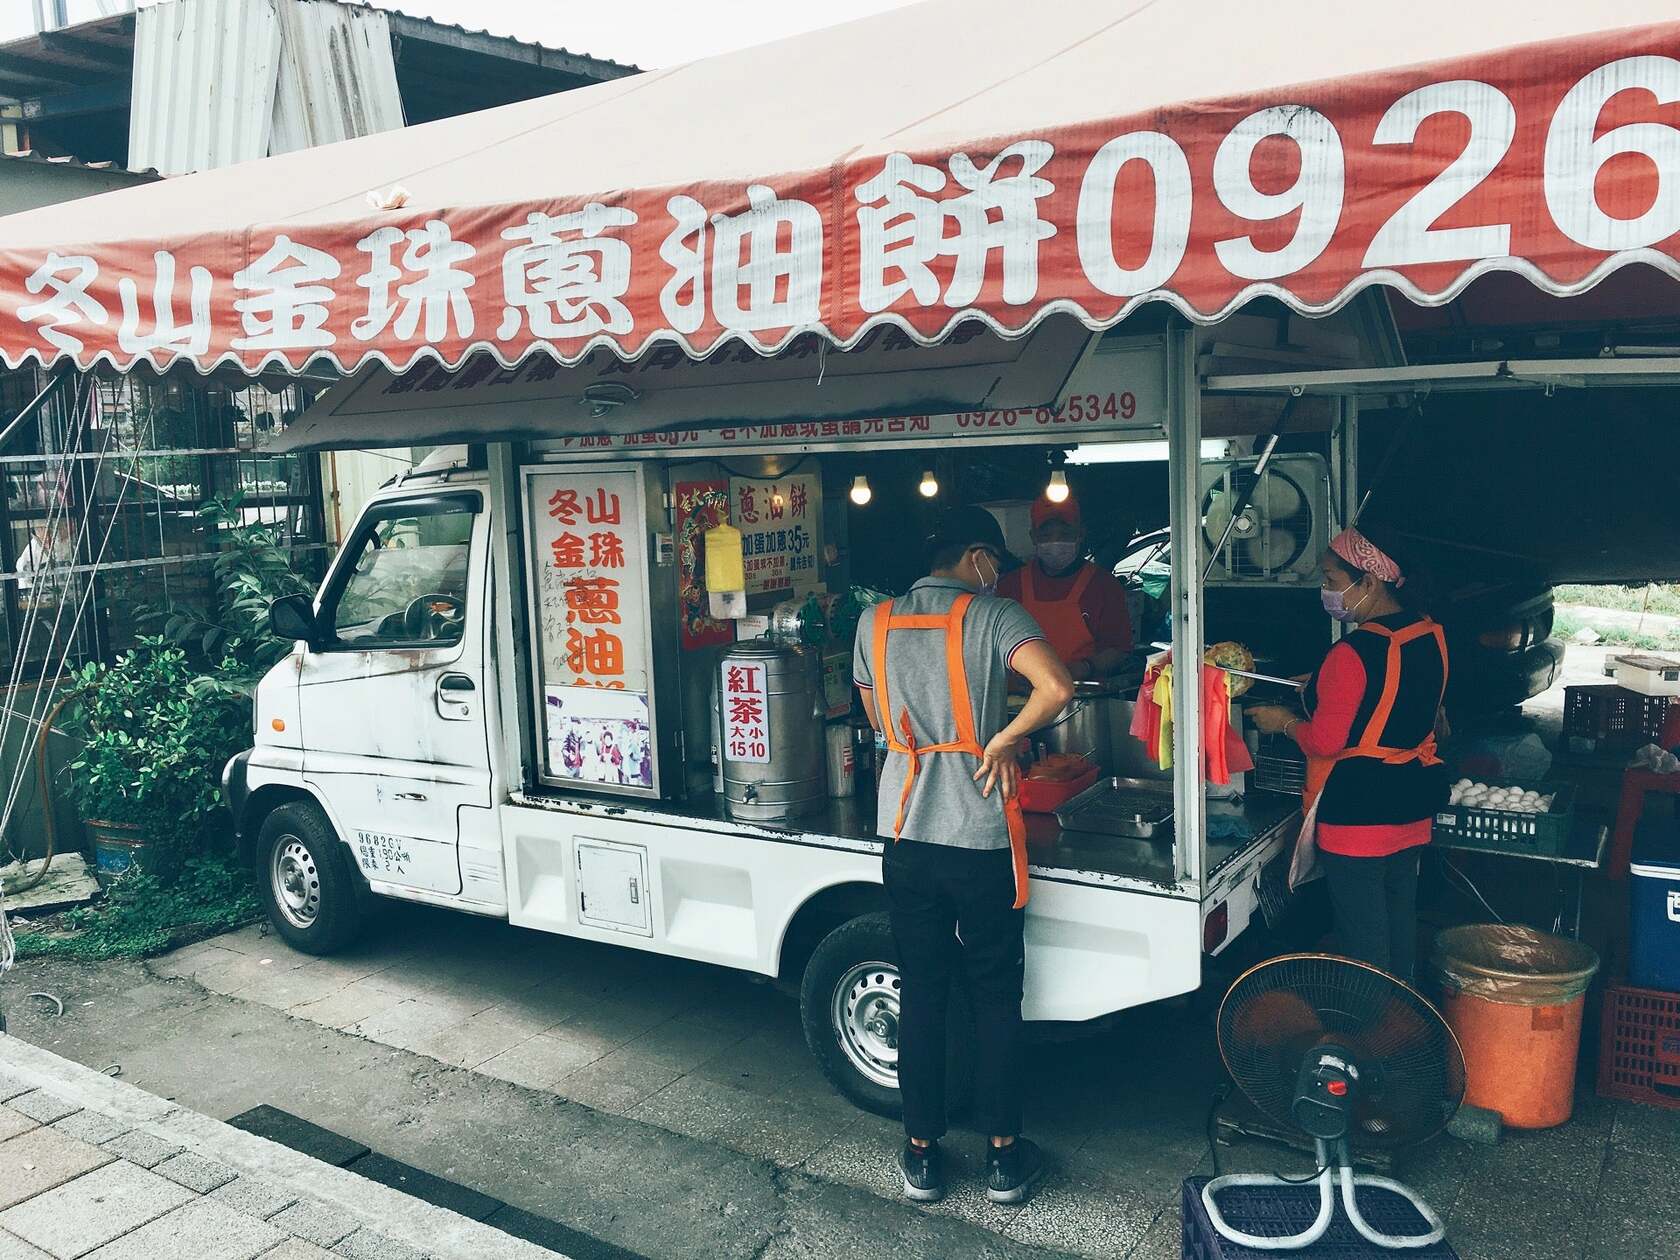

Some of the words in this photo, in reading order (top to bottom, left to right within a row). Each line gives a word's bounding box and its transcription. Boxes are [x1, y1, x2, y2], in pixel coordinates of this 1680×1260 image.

[16, 140, 1059, 357] 冬山金珠蔥油餅
[1077, 54, 1680, 299] 0926
[956, 391, 1137, 428] 0926-825349
[548, 487, 620, 525] 冬山
[551, 531, 625, 568] 金珠
[562, 576, 624, 690] 蔥油
[727, 665, 763, 725] 紅茶
[729, 741, 746, 756] 15
[749, 742, 765, 757] 10
[730, 726, 745, 739] 大
[749, 727, 764, 739] 小
